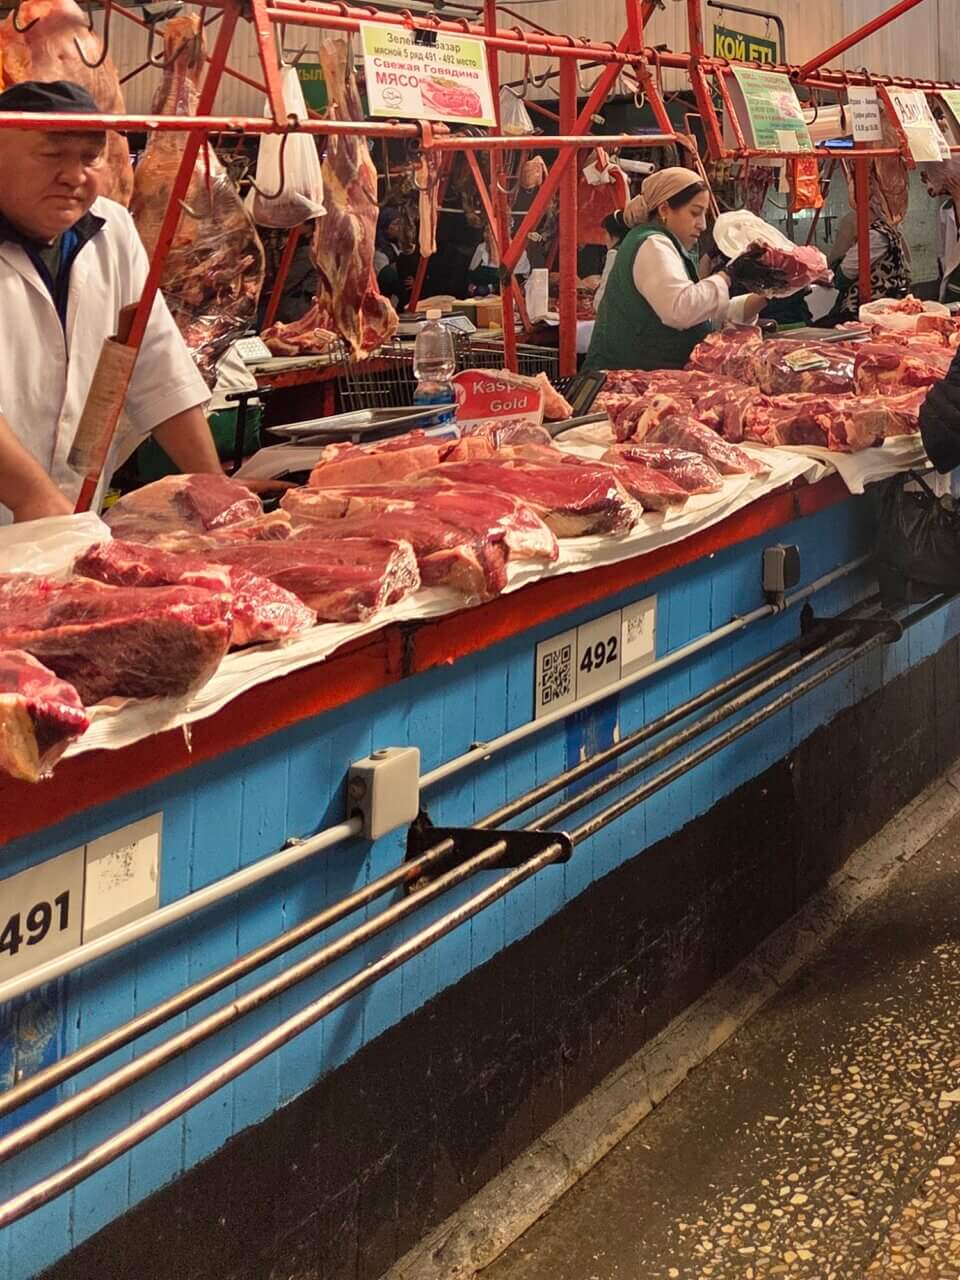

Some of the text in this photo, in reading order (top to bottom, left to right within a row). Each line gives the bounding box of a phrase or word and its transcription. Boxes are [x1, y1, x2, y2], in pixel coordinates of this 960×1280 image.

[403, 48, 408, 58] 5
[410, 50, 424, 61] ряд
[425, 51, 437, 62] 491
[443, 54, 455, 65] 492
[456, 58, 477, 67] место
[373, 57, 479, 79] Свежая Говядина
[375, 71, 419, 88] МЯСО
[490, 396, 528, 412] Gold
[580, 635, 618, 674] 492
[0, 889, 70, 957] 491
